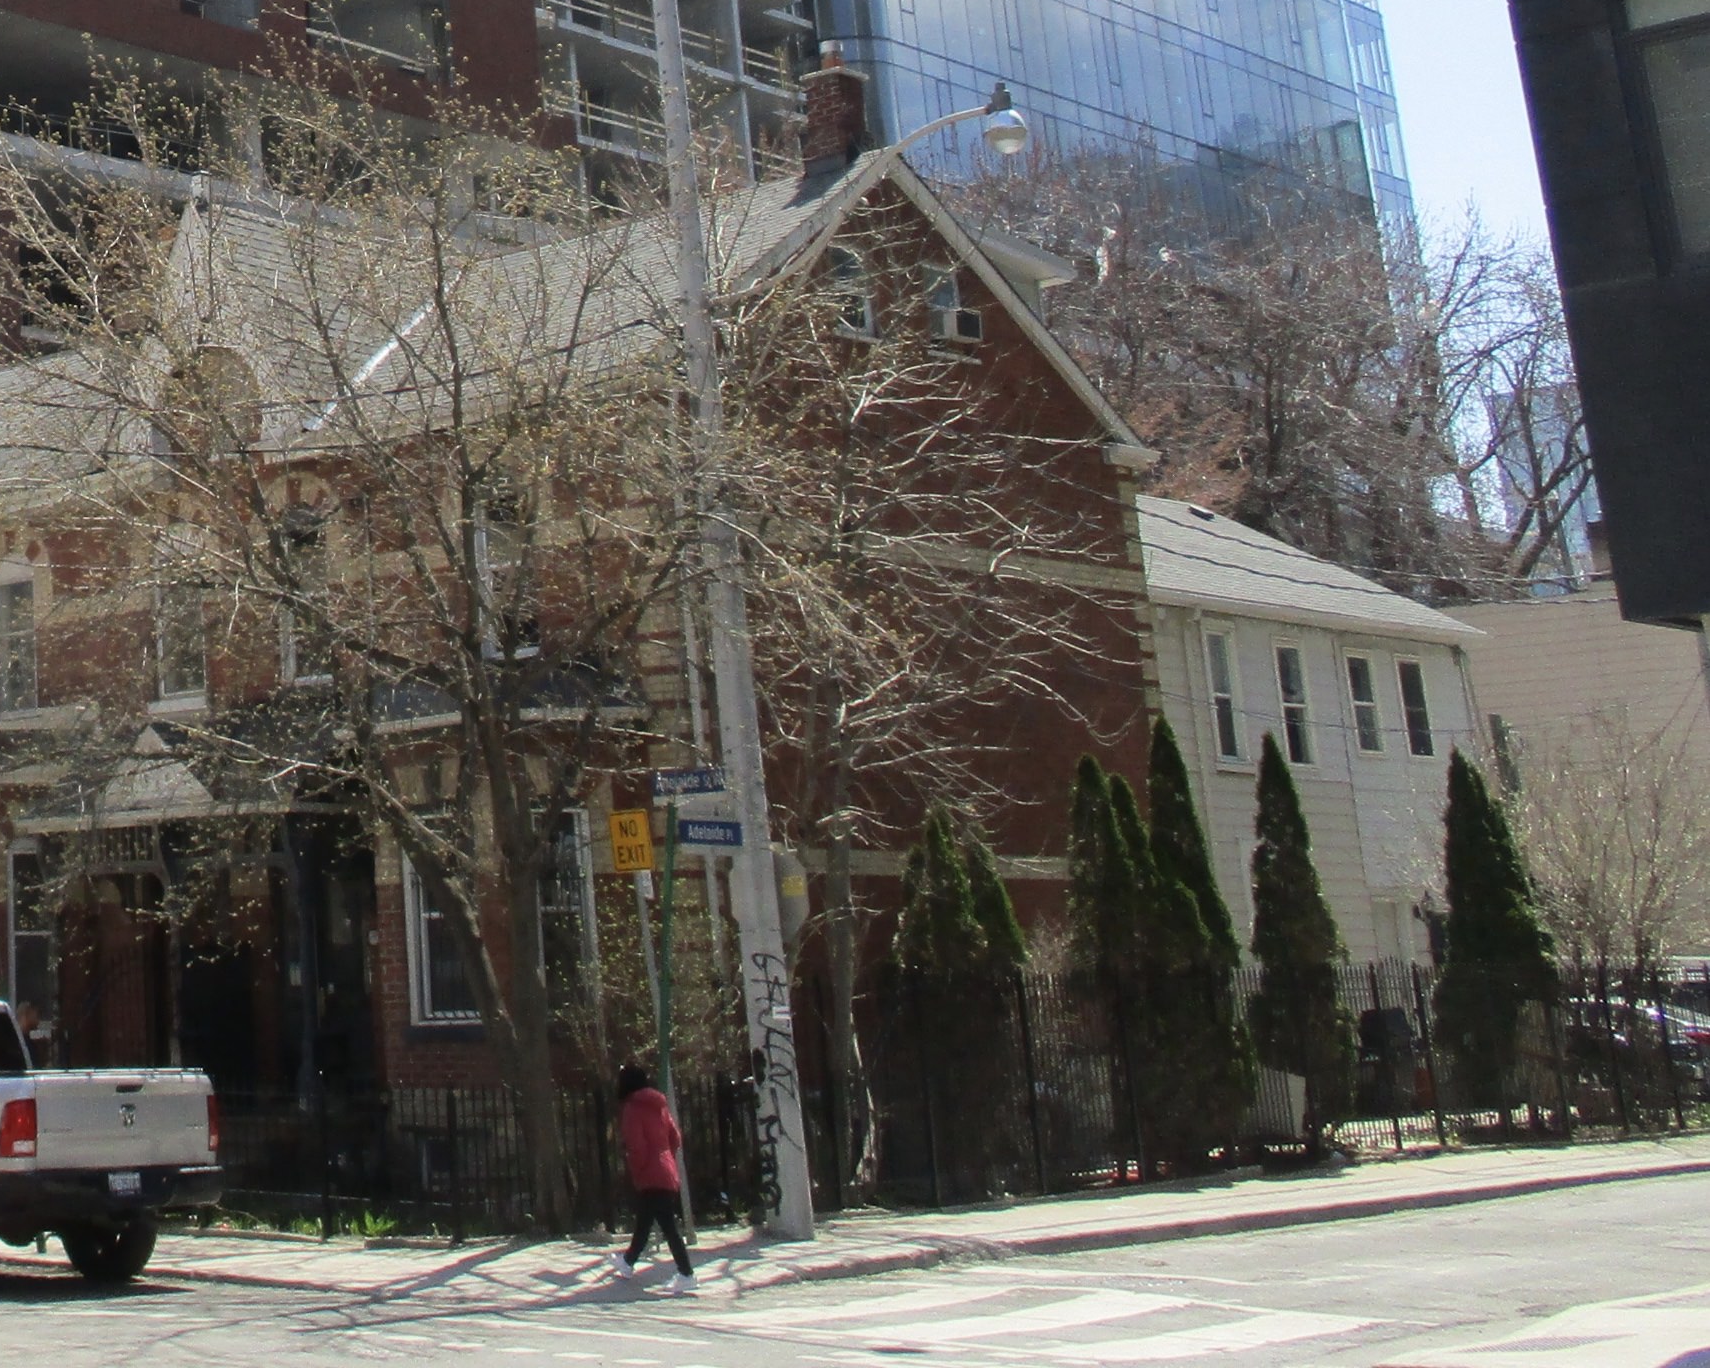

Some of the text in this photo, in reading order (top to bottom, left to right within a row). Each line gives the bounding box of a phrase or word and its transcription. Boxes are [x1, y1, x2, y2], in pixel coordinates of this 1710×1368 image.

[619, 819, 638, 838] NO
[688, 824, 724, 841] Adelaide
[617, 844, 646, 864] EXIT
